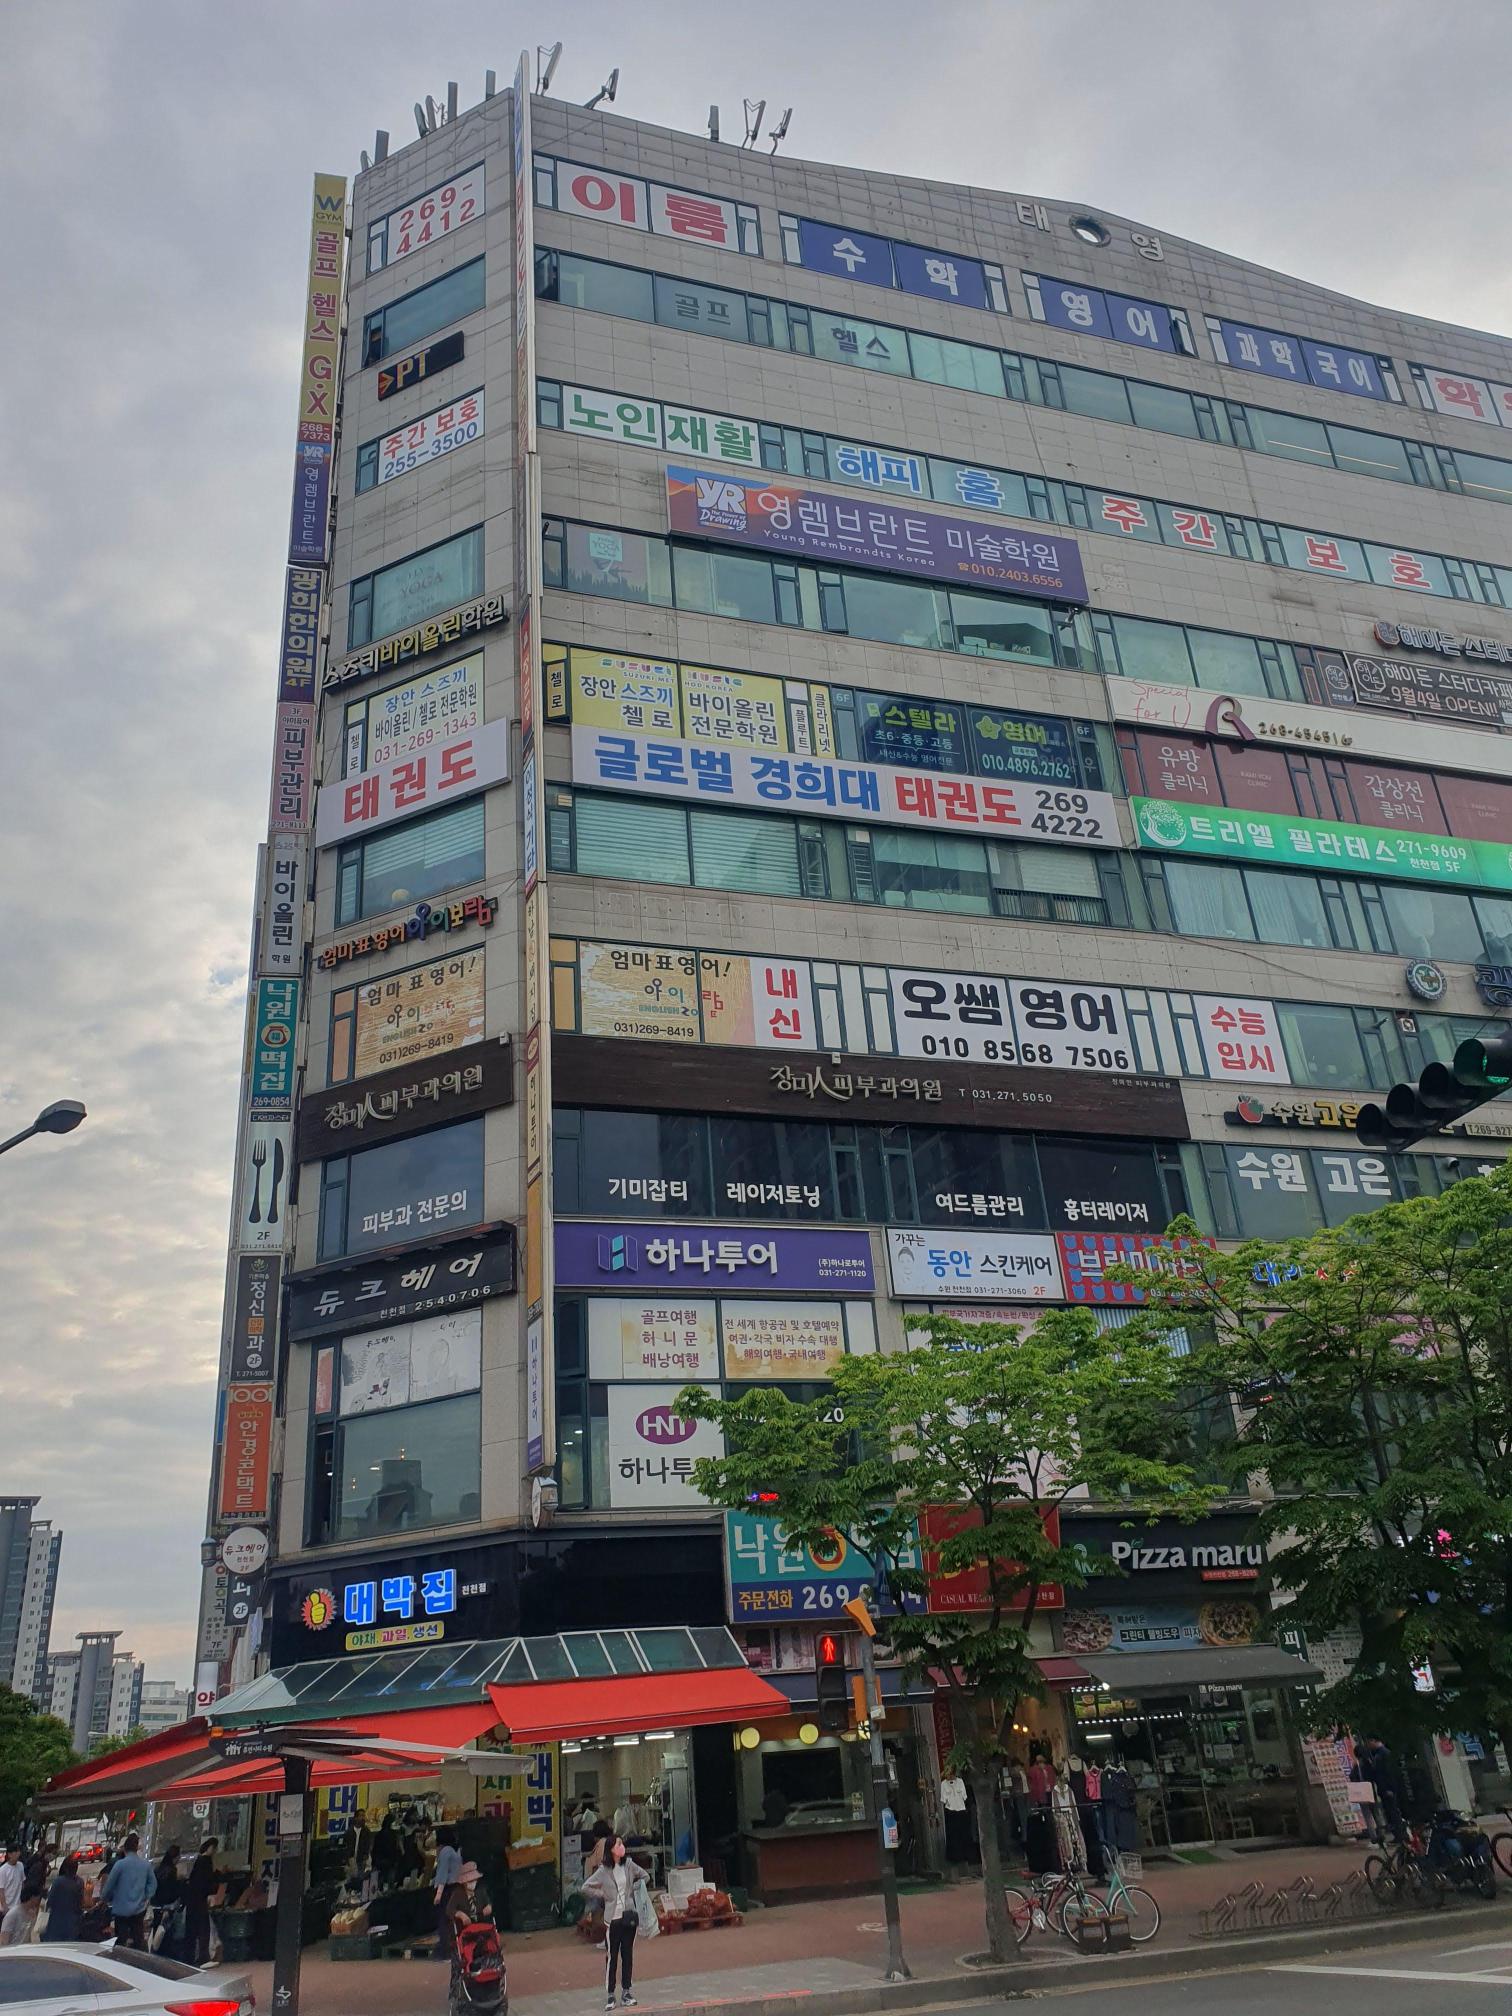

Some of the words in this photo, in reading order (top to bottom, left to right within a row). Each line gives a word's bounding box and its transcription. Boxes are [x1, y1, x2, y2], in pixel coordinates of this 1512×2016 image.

[316, 212, 342, 222] GYM
[396, 199, 475, 255] 4412
[314, 231, 340, 279] 골프
[310, 293, 337, 341] 헬스
[676, 293, 731, 325] 골프
[831, 327, 890, 359] 헬스
[397, 348, 431, 388] PT
[303, 431, 330, 441] 7373
[384, 422, 478, 480] 255-3500
[836, 445, 923, 494] 해피
[696, 478, 746, 515] YR
[700, 509, 746, 530] Drawing
[757, 491, 933, 556] 영렘브란트
[946, 529, 1060, 572] 미술학원
[763, 529, 806, 547] Young
[898, 553, 936, 567] Korea
[971, 562, 1064, 588] 010.2403.6556
[386, 689, 415, 714] 장안
[441, 683, 477, 717] 전문학원
[580, 675, 617, 698] 장안
[620, 681, 673, 708] 스즈끼
[689, 692, 775, 722] 바이올린
[1446, 696, 1500, 717] OPEN!!
[691, 716, 778, 745] 전문학원
[884, 705, 956, 733] 스텔라
[374, 711, 477, 764] 031-269-1343
[982, 755, 1072, 780] 010.4896.2762
[1158, 746, 1200, 774] 유방
[343, 740, 476, 824] 태권도
[594, 735, 734, 794] 글로벌
[751, 756, 880, 812] 경희대
[895, 776, 1021, 825] 태권도
[1035, 790, 1088, 814] 269
[1160, 772, 1208, 795] 클리닉
[1365, 775, 1425, 803] 갑상선
[1031, 813, 1103, 839] 4222
[1379, 801, 1425, 823] 클리닉
[1188, 815, 1276, 849] 트리엘
[1287, 826, 1397, 864] 필라테스
[1397, 839, 1467, 860] 271-9609
[1446, 861, 1461, 873] 5F
[266, 983, 296, 1020] 낙원
[902, 978, 1003, 1026] 오쌤
[1019, 988, 1118, 1035] 영어
[614, 1022, 694, 1037] 031)269-8419
[1211, 1006, 1265, 1035] 수능
[379, 1033, 454, 1064] 031)269-8419
[922, 1035, 969, 1058] 010
[983, 1039, 1053, 1064] 8568
[1065, 1046, 1129, 1070] 7506
[1217, 1042, 1276, 1073] 입시
[260, 1051, 287, 1091] 떡집
[254, 1097, 290, 1106] 269-0854
[972, 1089, 1053, 1103] 031.271.5050
[1236, 1151, 1308, 1192] 수원
[1322, 1155, 1392, 1196] 고은
[362, 1205, 413, 1234] 피부과
[417, 1189, 467, 1223] 전문의
[608, 1178, 688, 1201] 기미잡티
[727, 1183, 820, 1208] 레이저토닝
[935, 1192, 1024, 1217] 여드름관리
[1064, 1199, 1149, 1223] 흉터레이저
[257, 1232, 271, 1240] 2F
[895, 1233, 926, 1247] 가꾸는
[645, 1238, 777, 1275] 하나투어
[927, 1249, 972, 1278] 동안
[980, 1253, 1052, 1278] 스킨케어
[1033, 1286, 1047, 1295] 2F
[641, 1310, 697, 1325] 골프여행
[759, 1320, 787, 1330] 항공권
[803, 1320, 839, 1331] 호텔예약
[776, 1335, 794, 1345] 비자
[798, 1335, 816, 1345] 수속
[819, 1335, 838, 1346] 대행
[642, 1352, 699, 1369] 배낭여행
[1112, 1541, 1186, 1569] Pizza
[1192, 1544, 1262, 1567] maru
[236, 1606, 246, 1615] 2F
[344, 1569, 456, 1624] 대박집
[738, 1589, 794, 1611] 주문전화
